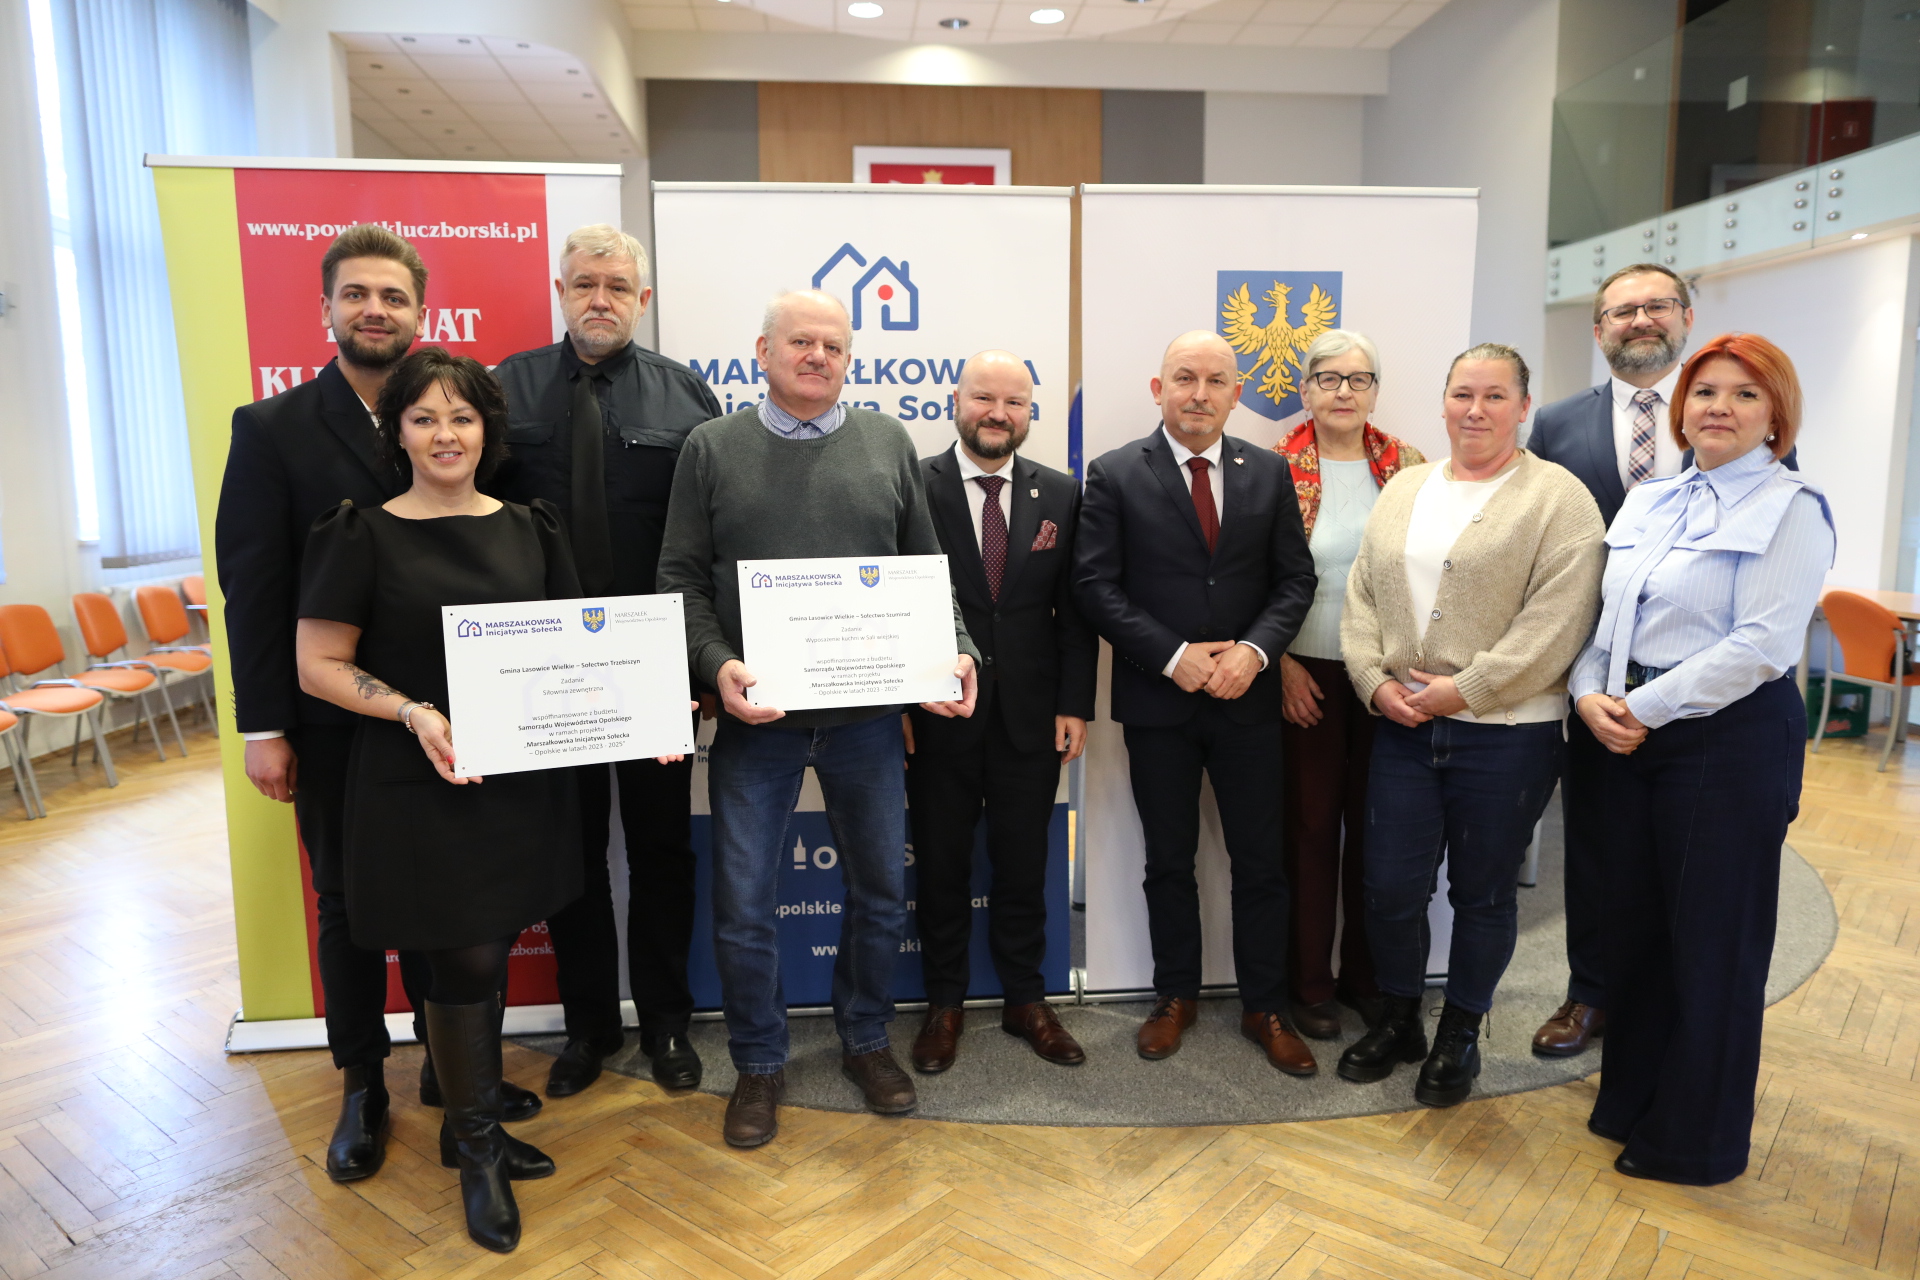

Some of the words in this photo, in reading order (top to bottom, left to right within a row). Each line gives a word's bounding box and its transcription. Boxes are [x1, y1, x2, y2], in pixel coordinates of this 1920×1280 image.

[246, 221, 538, 242] www.powkluczborski.pl
[775, 573, 842, 581] MARSZAŁKOWSKA
[614, 610, 648, 618] MARSZAŁEK
[485, 618, 562, 628] MARSZAŁKOWSKA
[486, 628, 528, 637] Inicjatywa
[531, 626, 563, 634] Sołecka
[610, 658, 641, 667] Trzebiszyn
[836, 664, 874, 672] Województwa
[542, 688, 569, 696] Siłownia
[569, 686, 604, 694] zewnętrzna
[532, 711, 588, 722] współfinansowane
[593, 708, 618, 716] budżetu
[518, 722, 553, 731] Samorządu
[554, 719, 598, 728] Województwa
[598, 716, 632, 724] Opolskiego
[555, 728, 578, 736] ramach
[579, 726, 605, 735] projektu
[574, 735, 606, 743] Inicjatywa
[534, 748, 561, 756] Opolskie
[568, 744, 588, 752] latach
